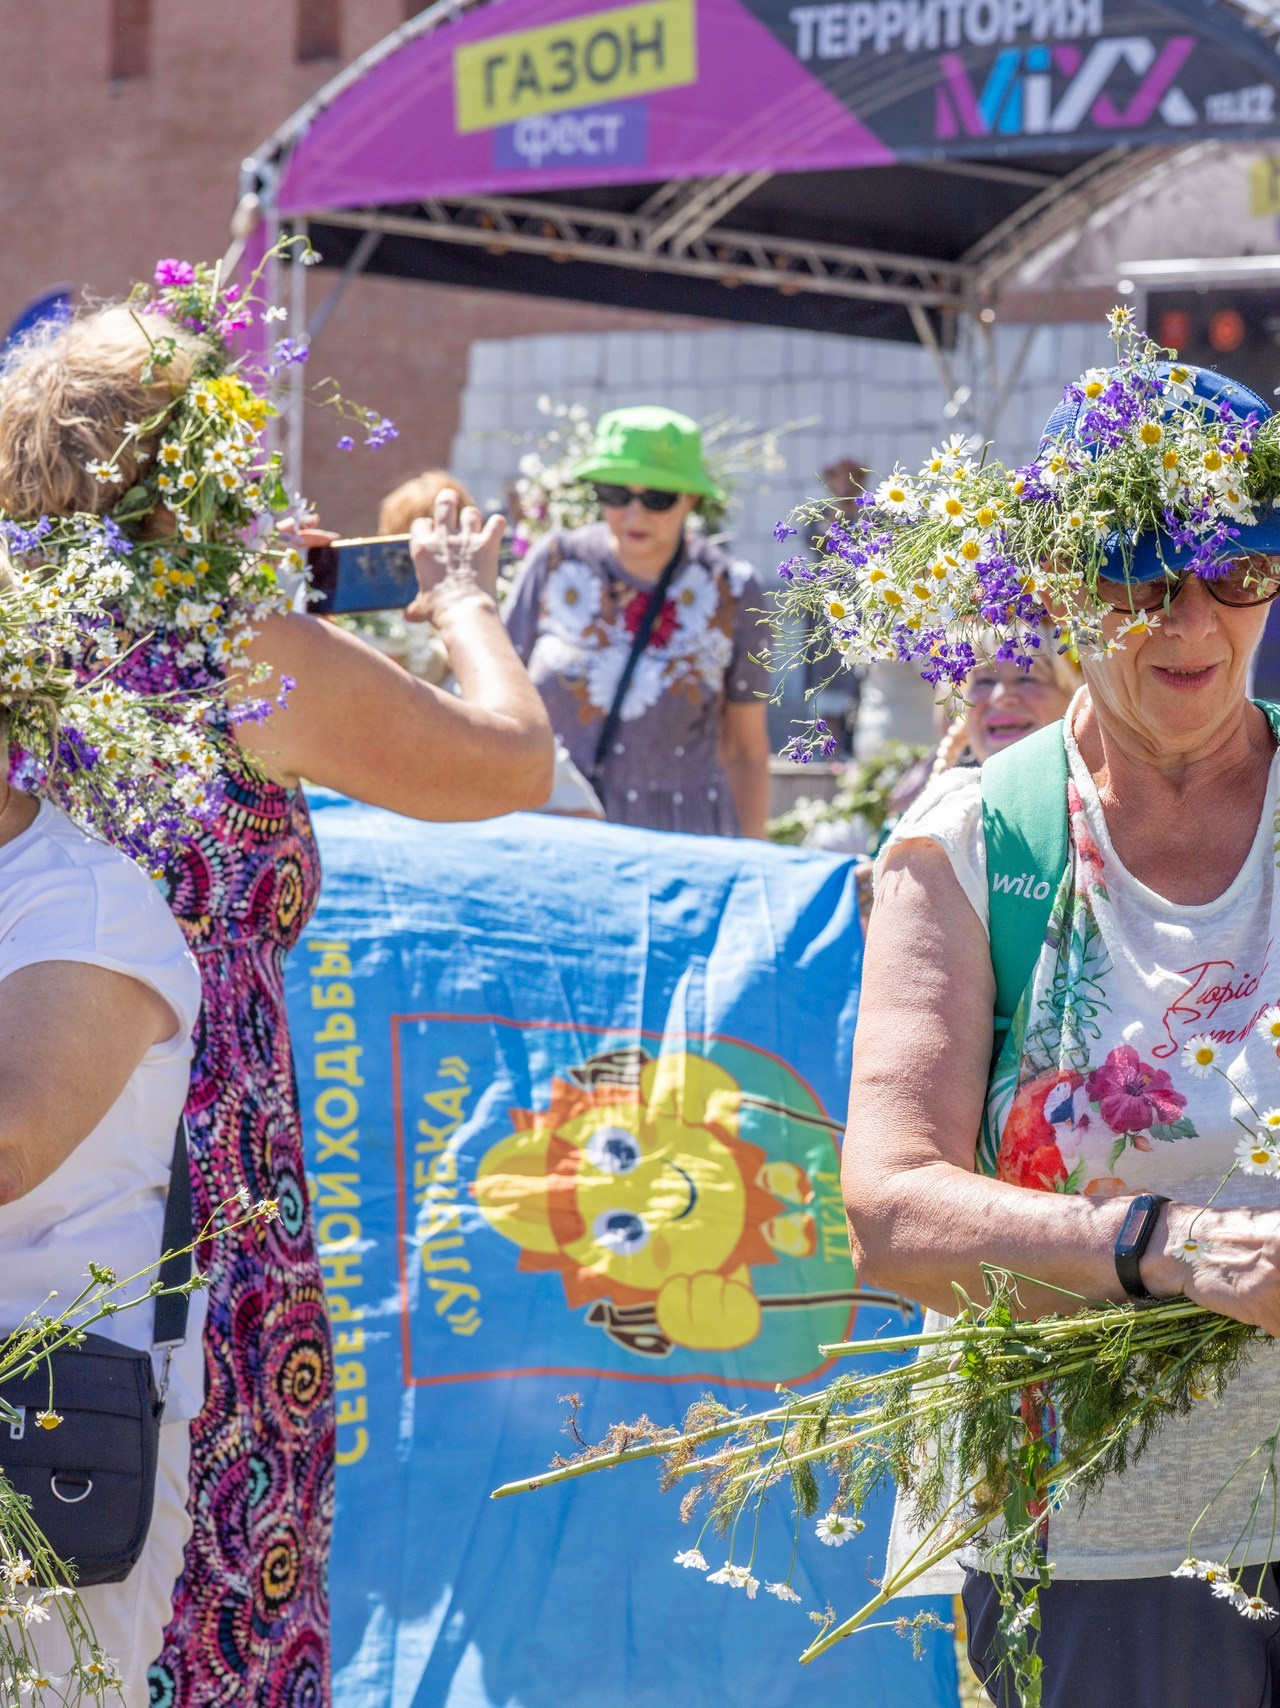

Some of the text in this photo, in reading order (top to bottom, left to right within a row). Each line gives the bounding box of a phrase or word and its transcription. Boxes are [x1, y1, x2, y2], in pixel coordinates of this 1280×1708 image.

[789, 0, 1102, 60] ТЕРРИТОРИЯ
[483, 18, 666, 108] ГАЗОН
[513, 113, 624, 167] фест
[992, 872, 1050, 900] wilo
[308, 940, 364, 1162] ХОДЬБЫ
